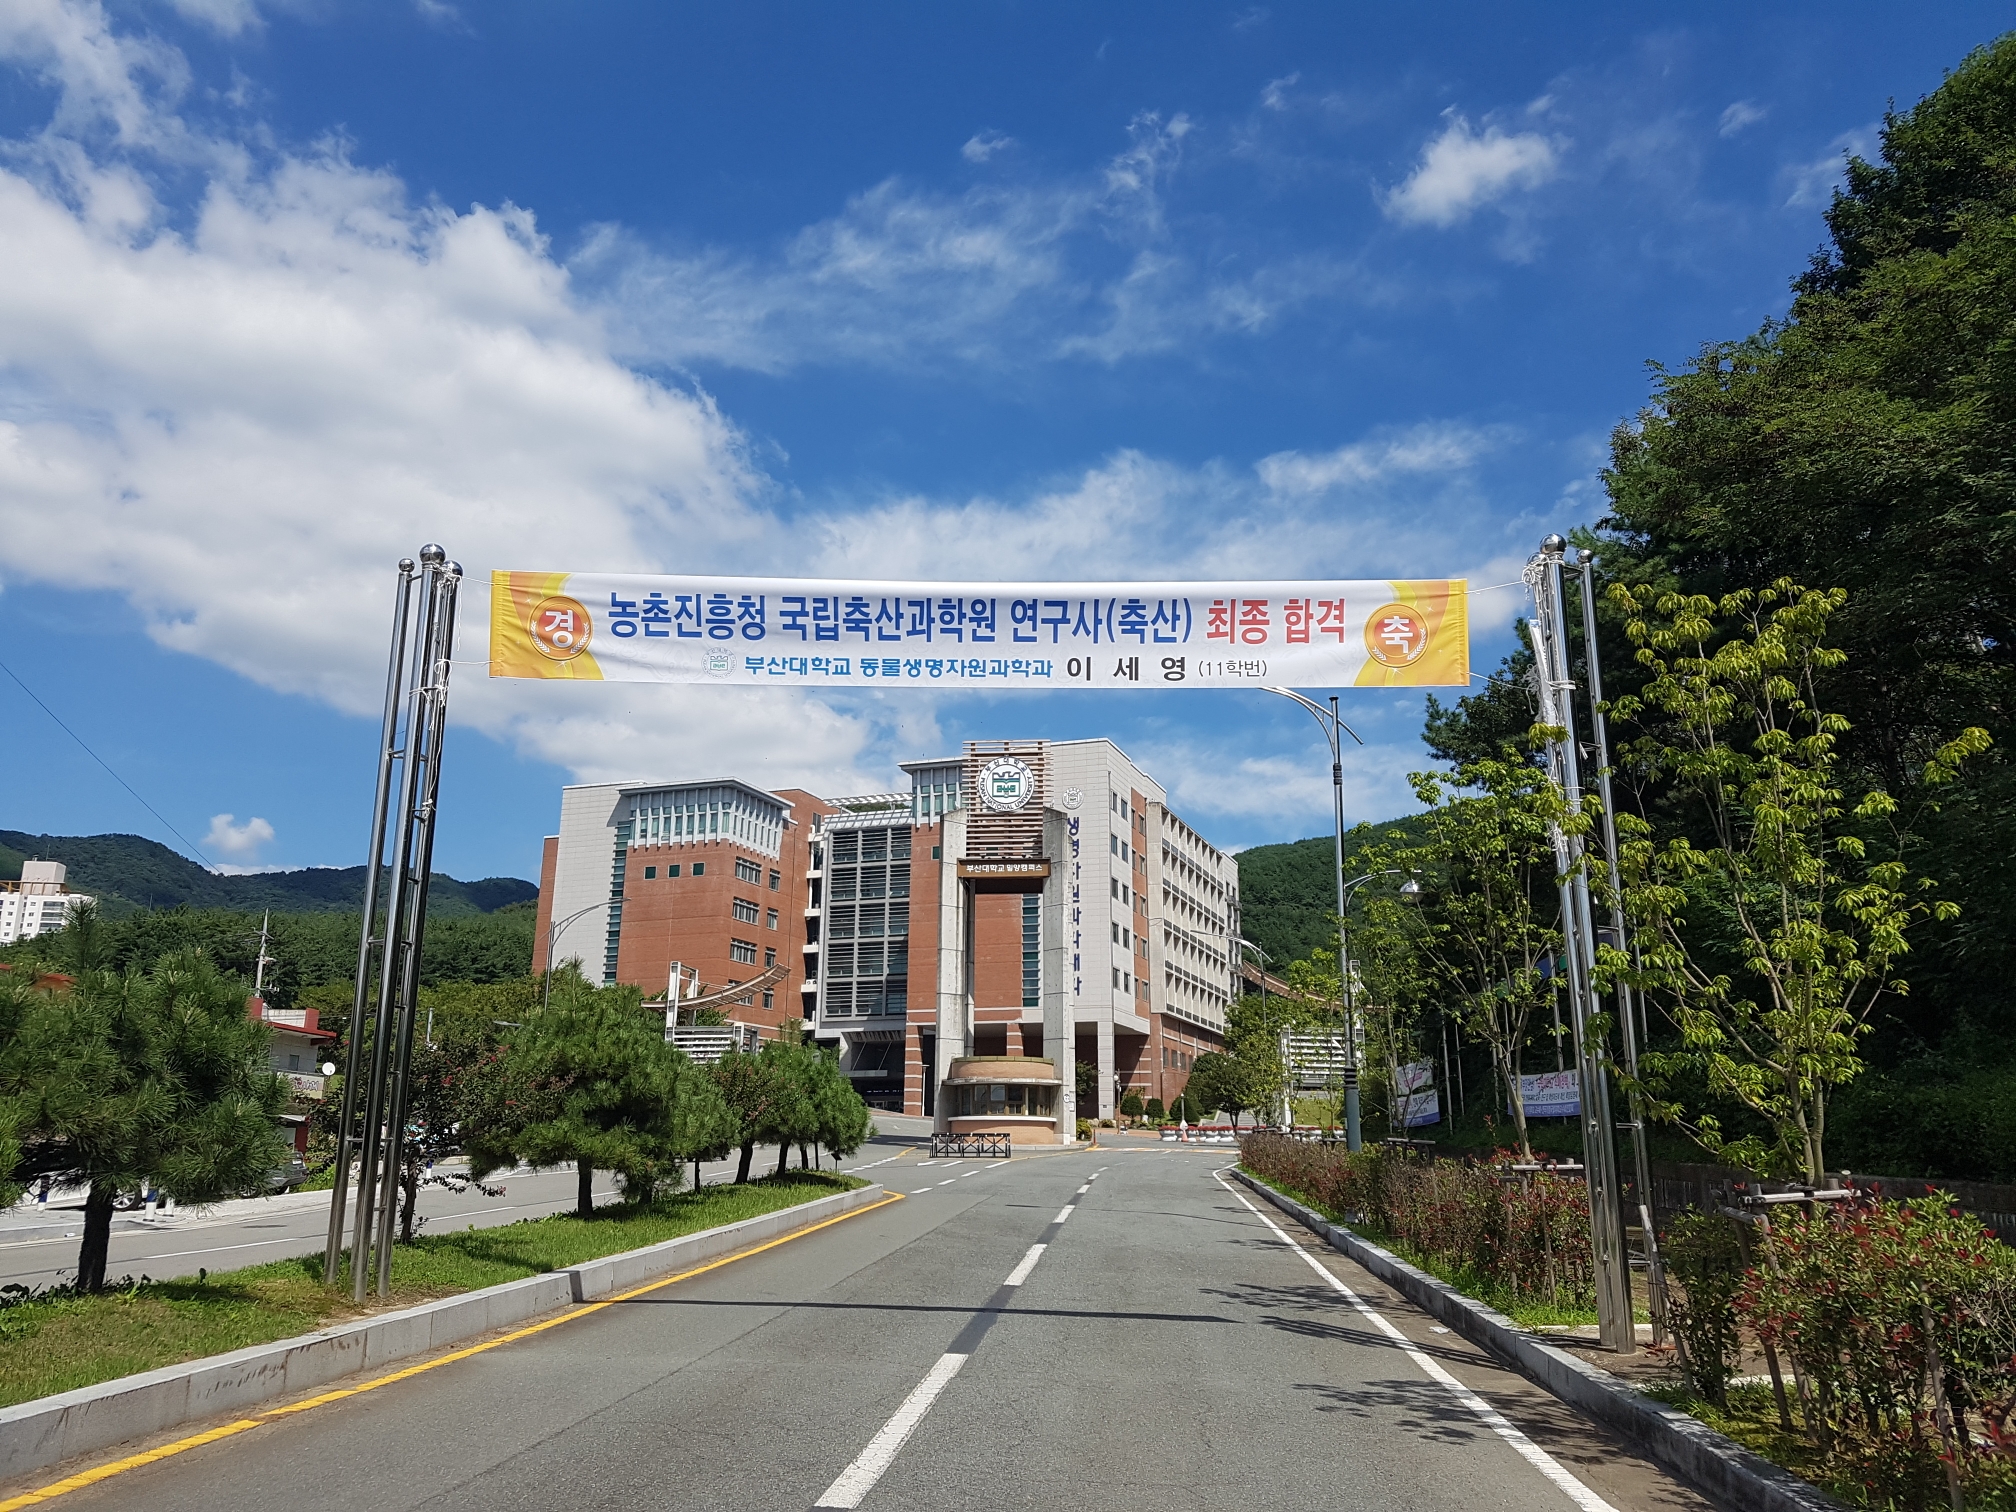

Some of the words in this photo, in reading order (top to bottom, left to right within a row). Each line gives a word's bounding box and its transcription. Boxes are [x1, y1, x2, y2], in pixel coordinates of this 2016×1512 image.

[545, 609, 574, 648] 경
[608, 592, 766, 640] 농촌진흥청
[779, 596, 996, 643] 국립축산과학원
[1010, 598, 1192, 644] 연구사(축산)
[1206, 598, 1270, 645] 최종
[1284, 598, 1345, 644] 합격
[1379, 616, 1415, 654] 축
[745, 656, 851, 677] 부산대학교
[859, 657, 1053, 678] 동물생명자원과학과
[1198, 659, 1268, 678] (11학번)
[985, 797, 1014, 810] NATIONAL
[966, 864, 1005, 873] 부산대학교
